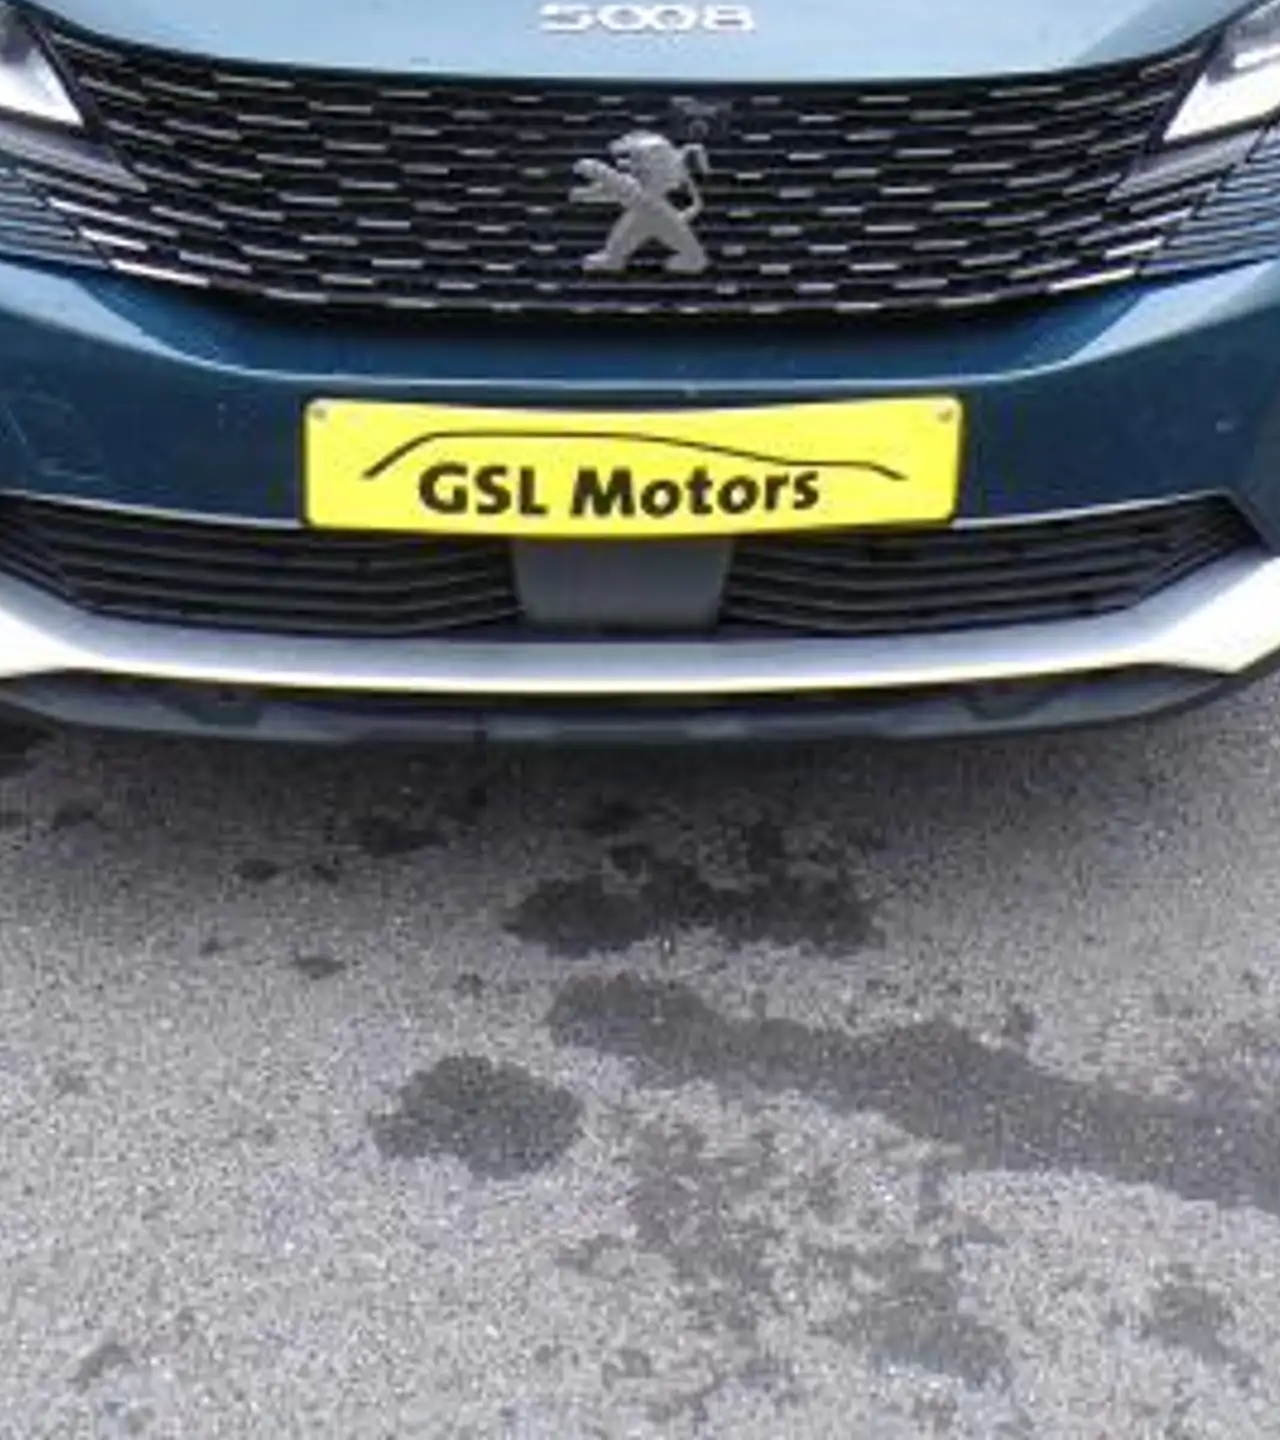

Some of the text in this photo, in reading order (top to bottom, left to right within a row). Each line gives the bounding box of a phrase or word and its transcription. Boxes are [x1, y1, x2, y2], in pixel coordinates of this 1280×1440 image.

[539, 4, 756, 32] 5008
[419, 462, 821, 518] GSL Motors
